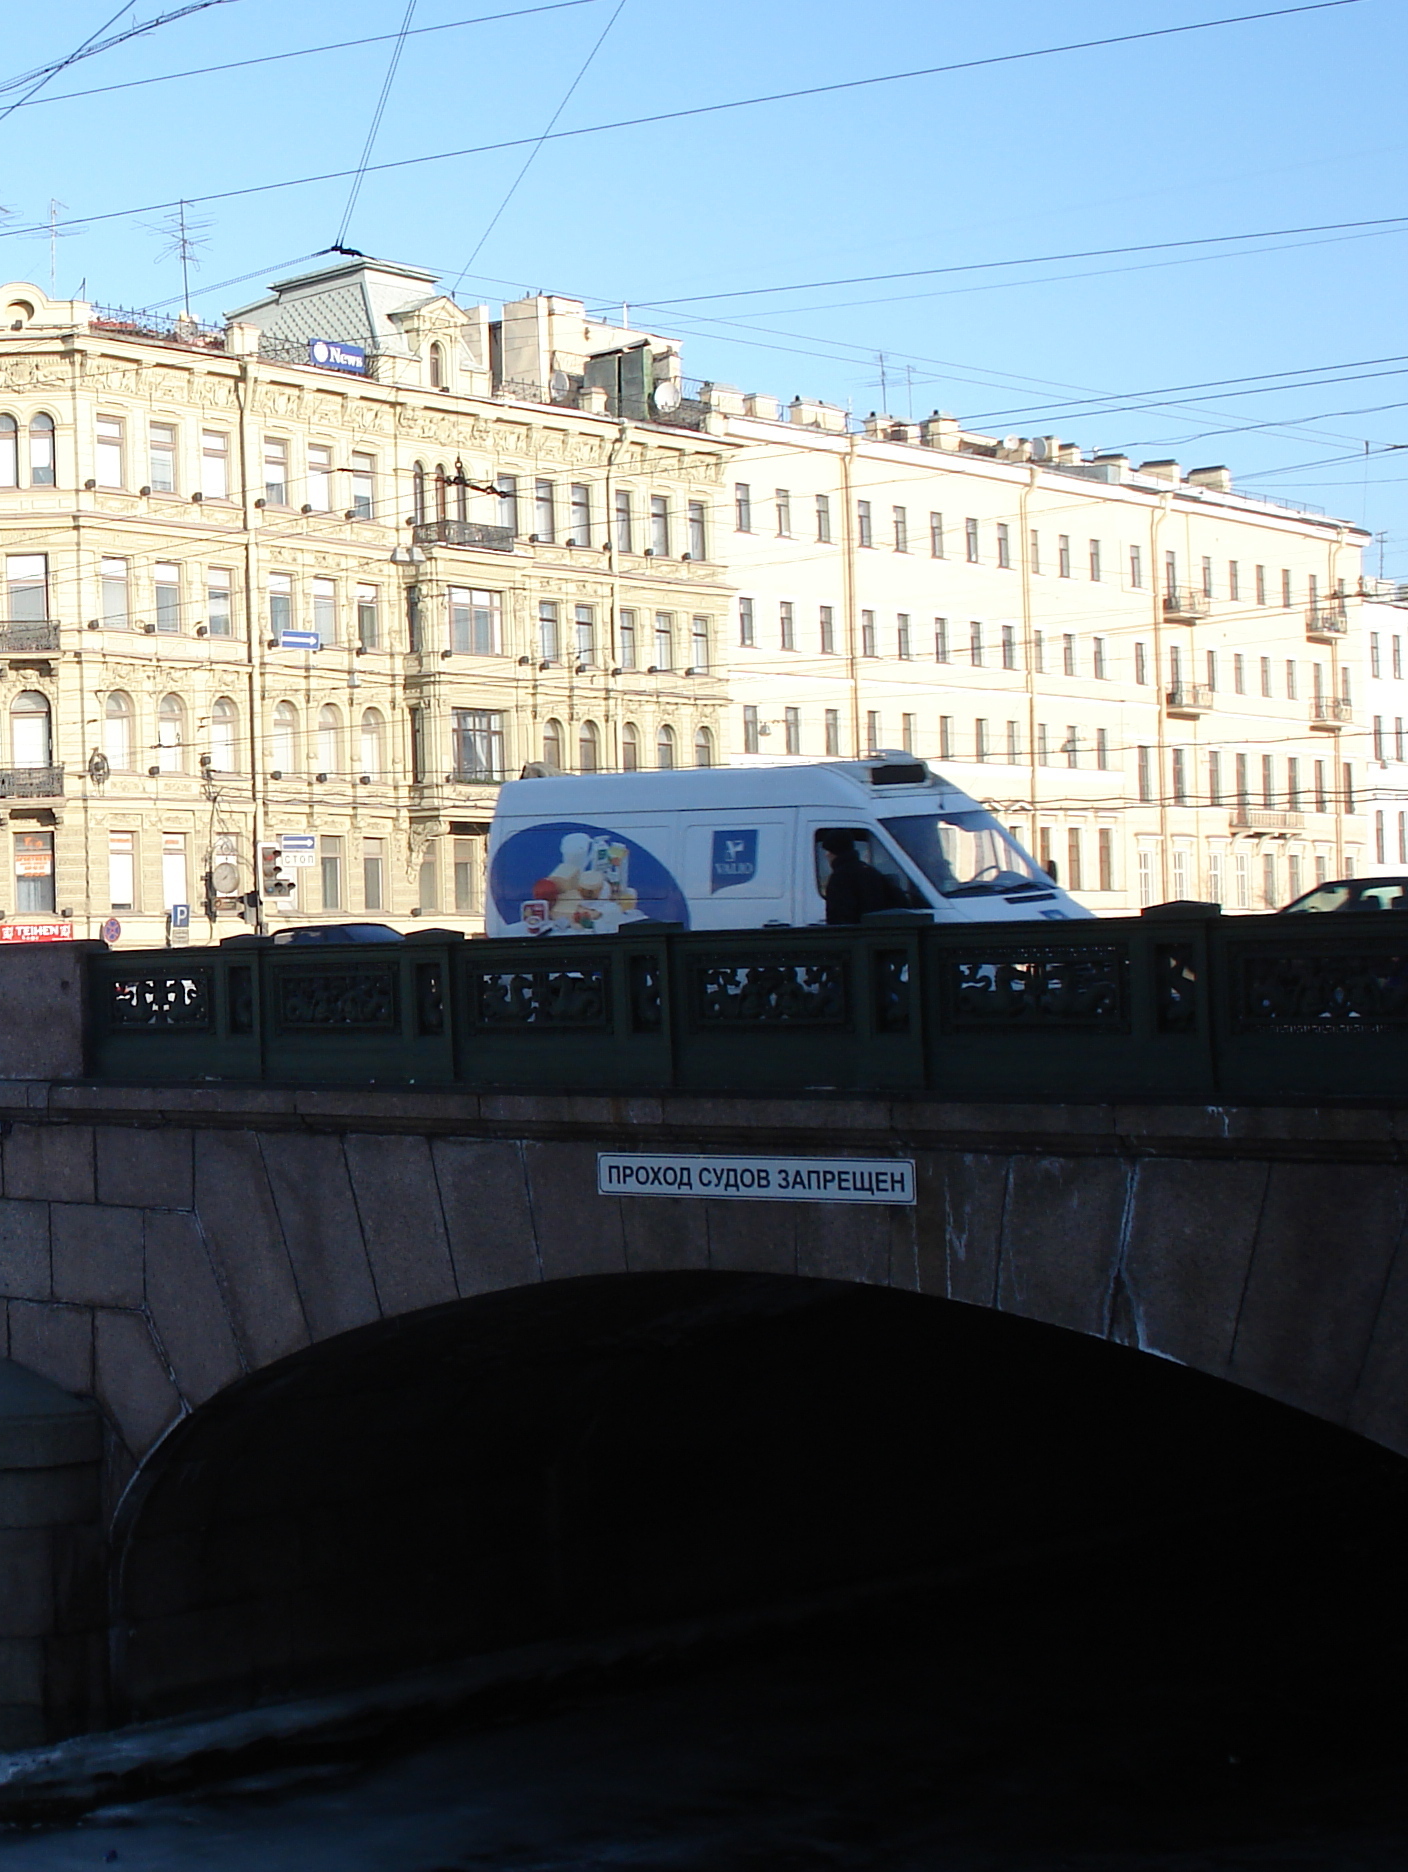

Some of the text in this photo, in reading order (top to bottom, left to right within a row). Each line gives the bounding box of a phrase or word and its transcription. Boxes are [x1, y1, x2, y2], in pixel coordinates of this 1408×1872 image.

[285, 855, 313, 864] СТОП
[714, 863, 753, 874] VALIO
[608, 1155, 905, 1196] ПРОХОД СУДОВ ЗАПРЕЩЕН
